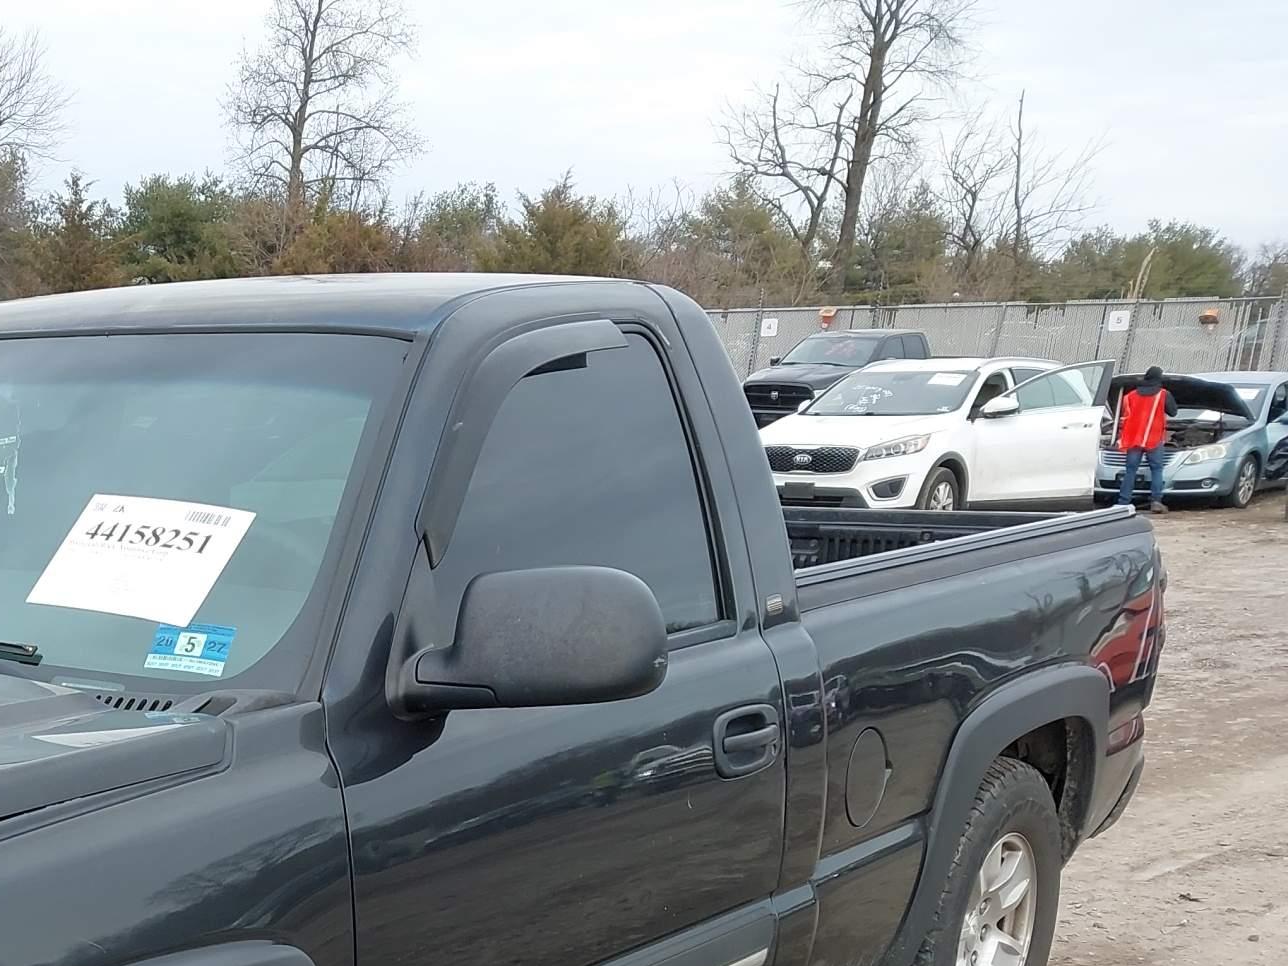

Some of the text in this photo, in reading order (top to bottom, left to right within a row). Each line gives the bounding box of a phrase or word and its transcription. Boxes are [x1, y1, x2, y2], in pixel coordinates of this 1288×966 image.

[85, 521, 213, 555] 44158251
[155, 634, 228, 655] 20 5 27
